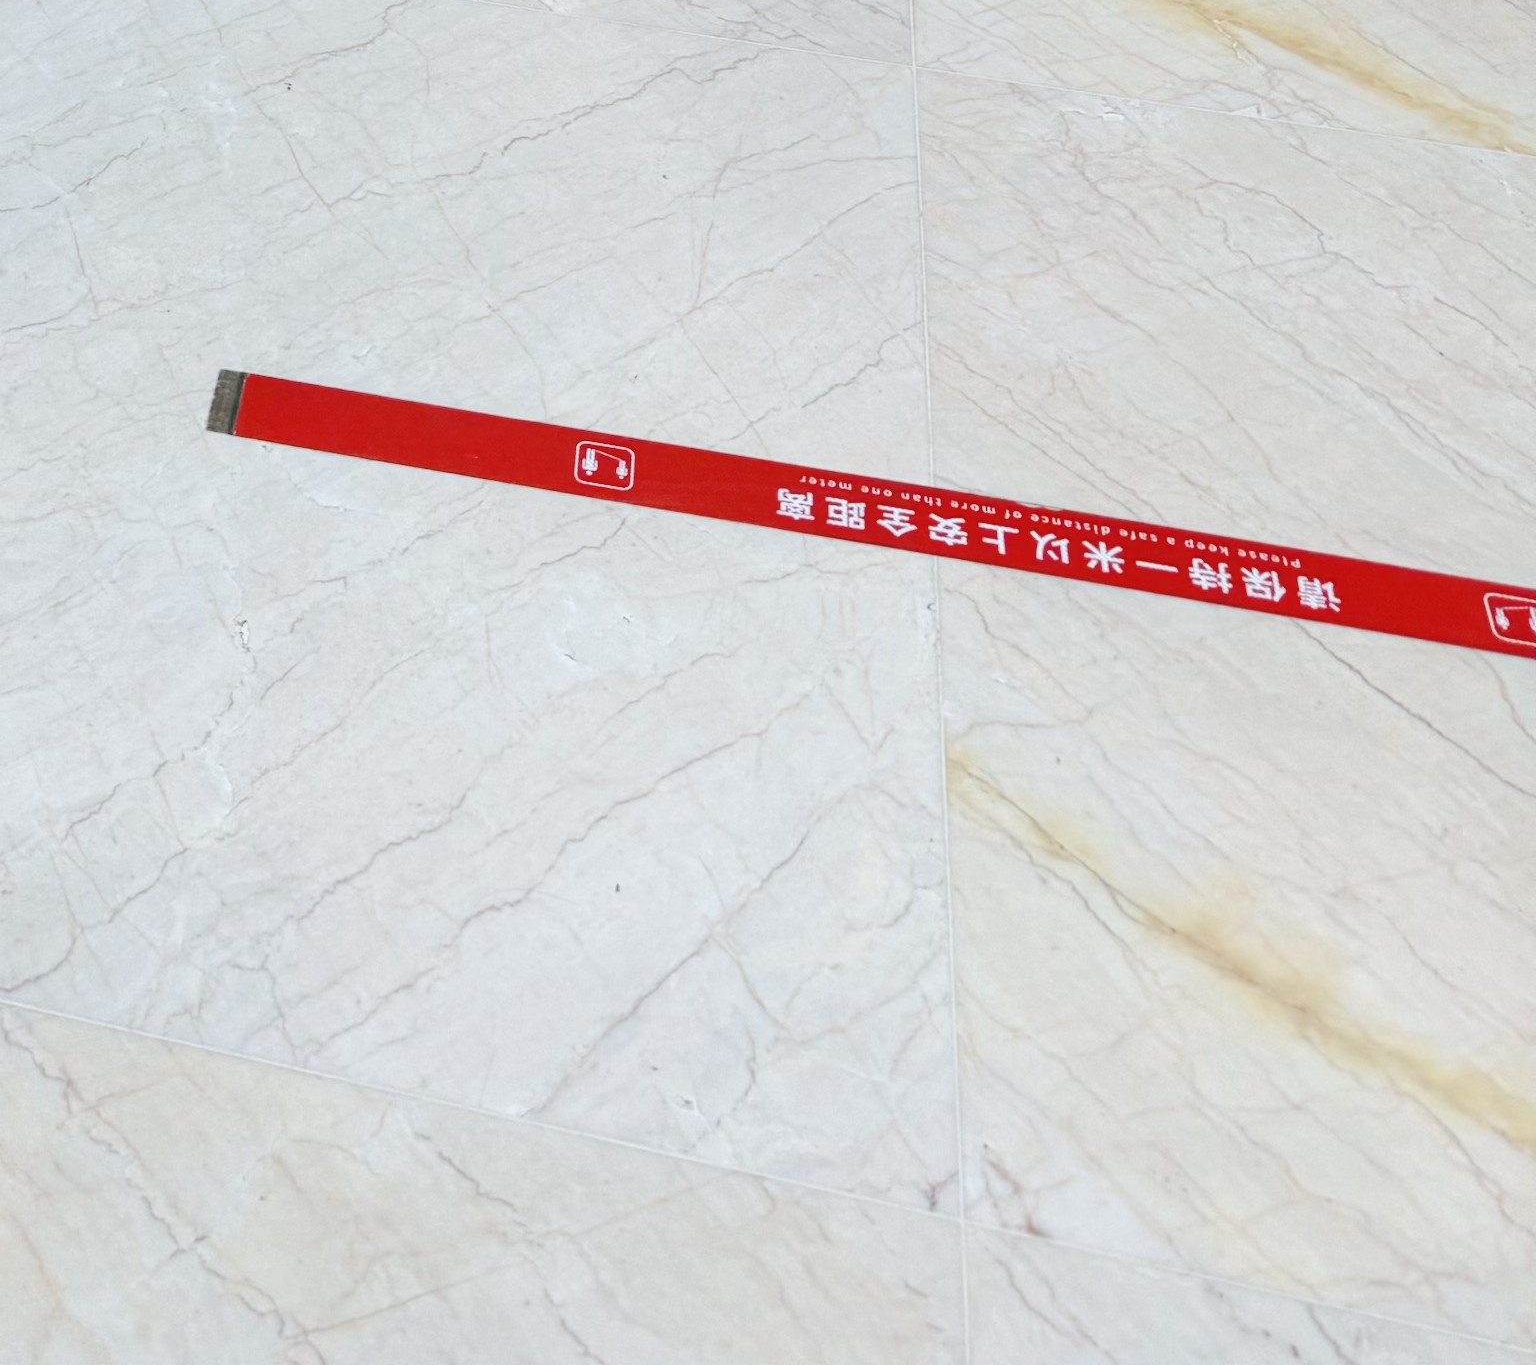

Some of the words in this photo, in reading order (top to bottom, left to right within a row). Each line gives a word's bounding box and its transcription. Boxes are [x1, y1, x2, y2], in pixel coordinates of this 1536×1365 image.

[799, 475, 853, 491] meter
[860, 485, 893, 498] one
[900, 492, 942, 507] than
[950, 500, 997, 515] more
[1004, 509, 1023, 520] of
[1030, 513, 1111, 536] distance
[1119, 528, 1158, 543] safe
[1166, 536, 1176, 546] a
[775, 487, 1342, 613] 请保持一米以上安全距离
[1184, 538, 1229, 557] keep
[1237, 548, 1301, 569] Please
